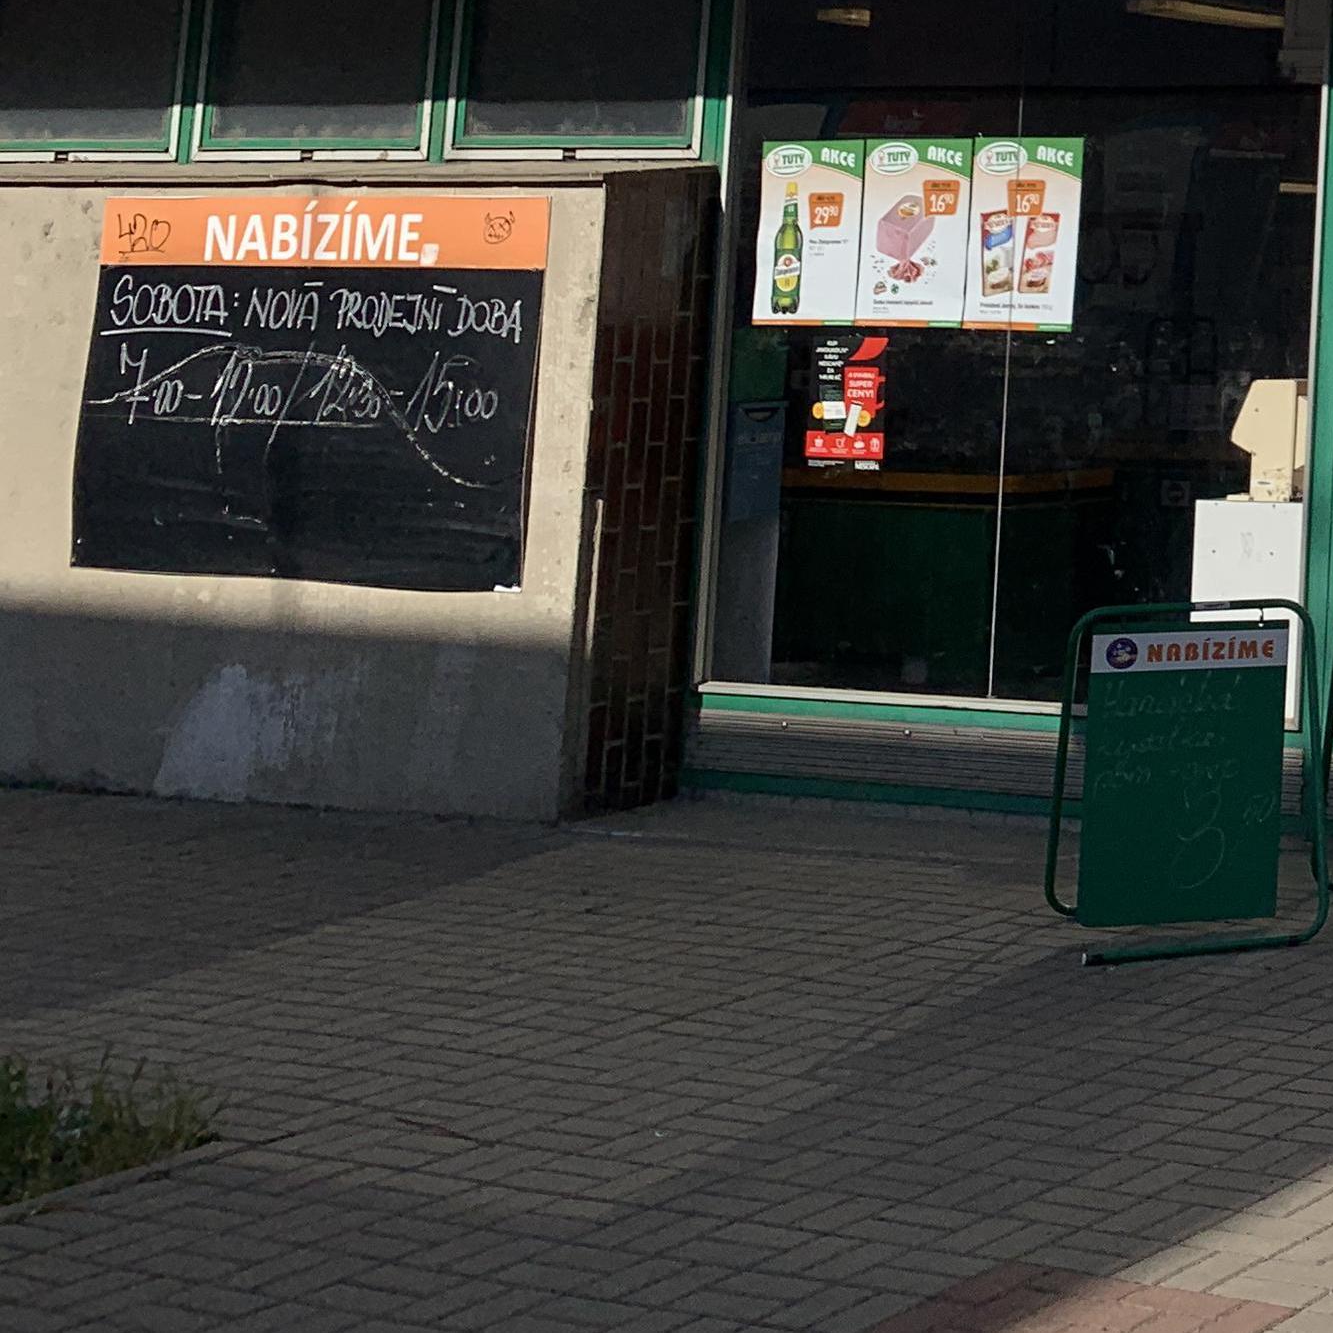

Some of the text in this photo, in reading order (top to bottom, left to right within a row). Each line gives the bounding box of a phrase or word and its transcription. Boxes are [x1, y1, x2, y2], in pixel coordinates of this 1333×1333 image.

[781, 153, 806, 165] TUTY
[820, 147, 856, 167] AKCE
[886, 151, 911, 163] TUTY
[927, 145, 963, 166] AKCE
[995, 150, 1020, 162] TUTY
[1036, 145, 1074, 167] AKCE
[447, 294, 522, 344] DOBA
[1146, 636, 1275, 664] NABÍZÍME
